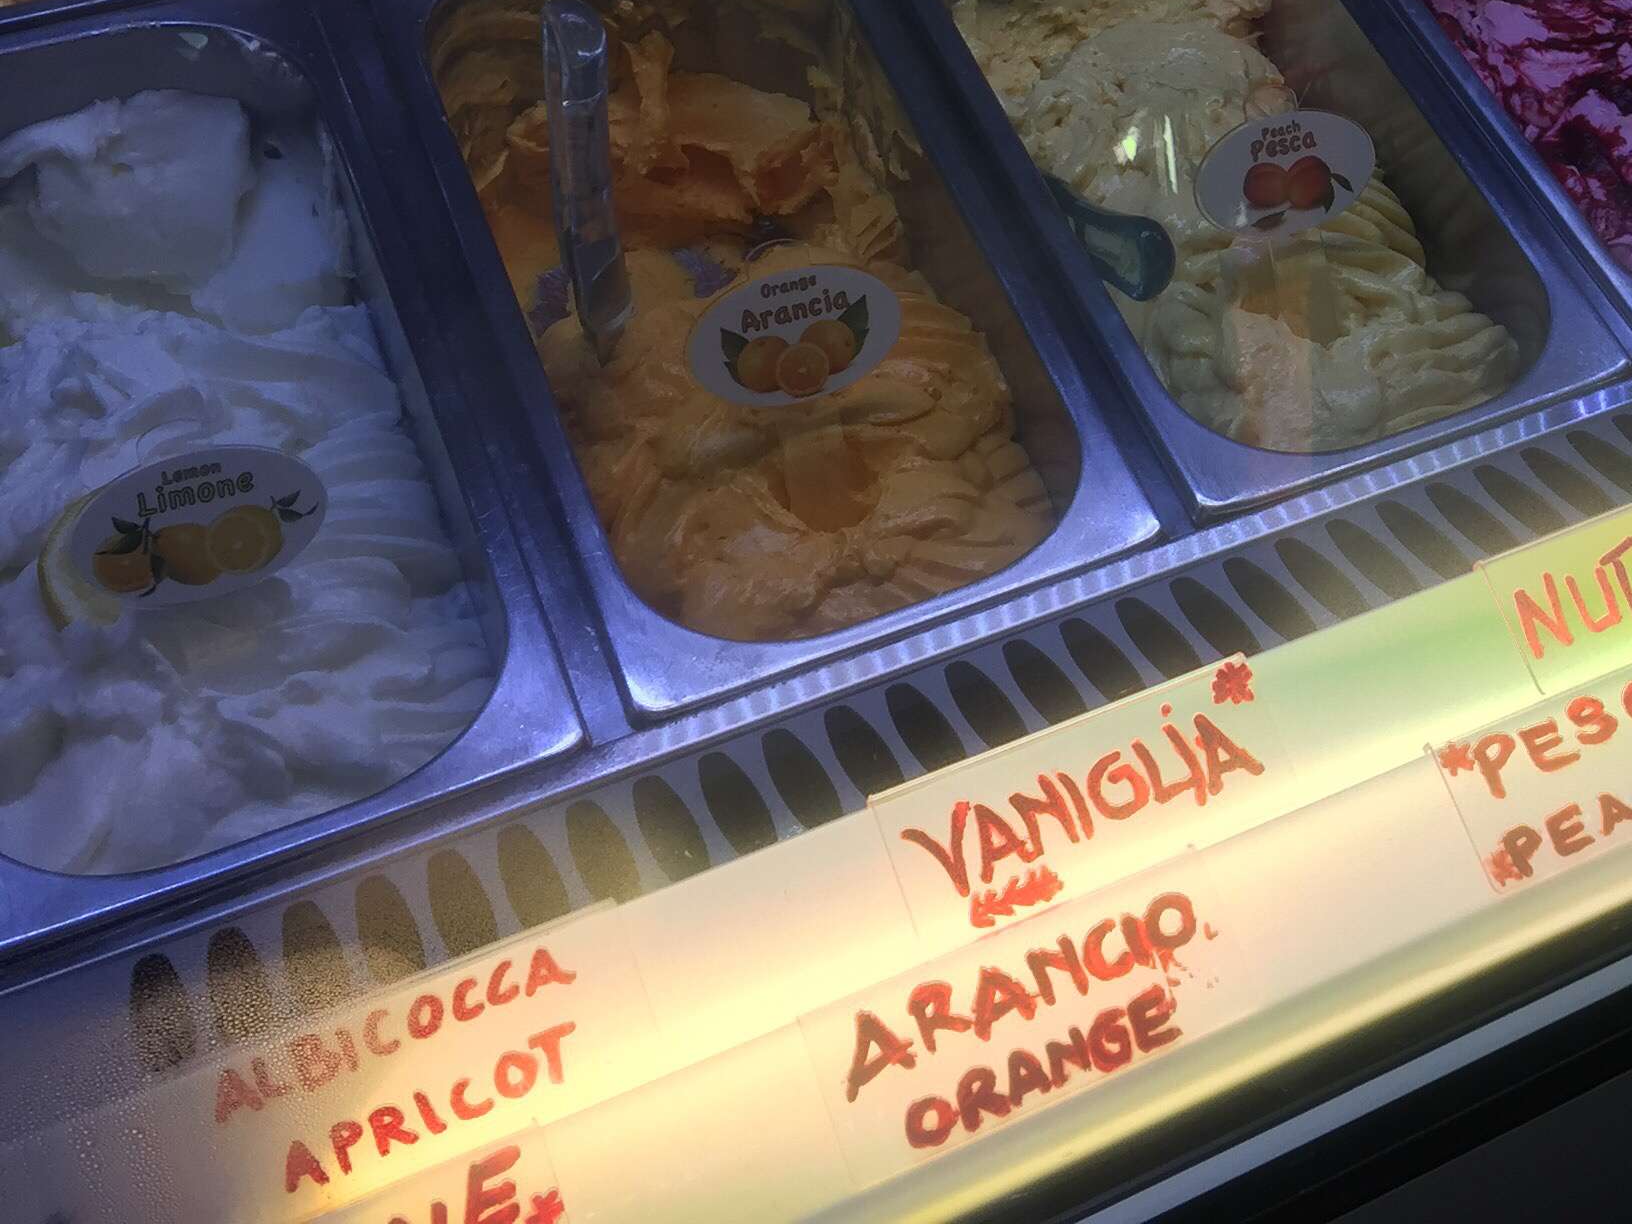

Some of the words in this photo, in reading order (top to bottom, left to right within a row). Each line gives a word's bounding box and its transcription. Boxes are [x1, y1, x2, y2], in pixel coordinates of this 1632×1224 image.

[1250, 131, 1318, 163] Pesca
[1261, 119, 1302, 141] Peach
[760, 272, 817, 300] Orange
[741, 289, 850, 334] Arancia
[137, 471, 255, 518] Limone
[161, 461, 222, 486] Lemon
[900, 703, 1265, 897] VANIGLIA
[847, 891, 1197, 1102] ARANCIO
[214, 947, 576, 1123] ALBICOCCA
[905, 983, 1183, 1149] ORANGE
[284, 1022, 577, 1193] APRICOT
